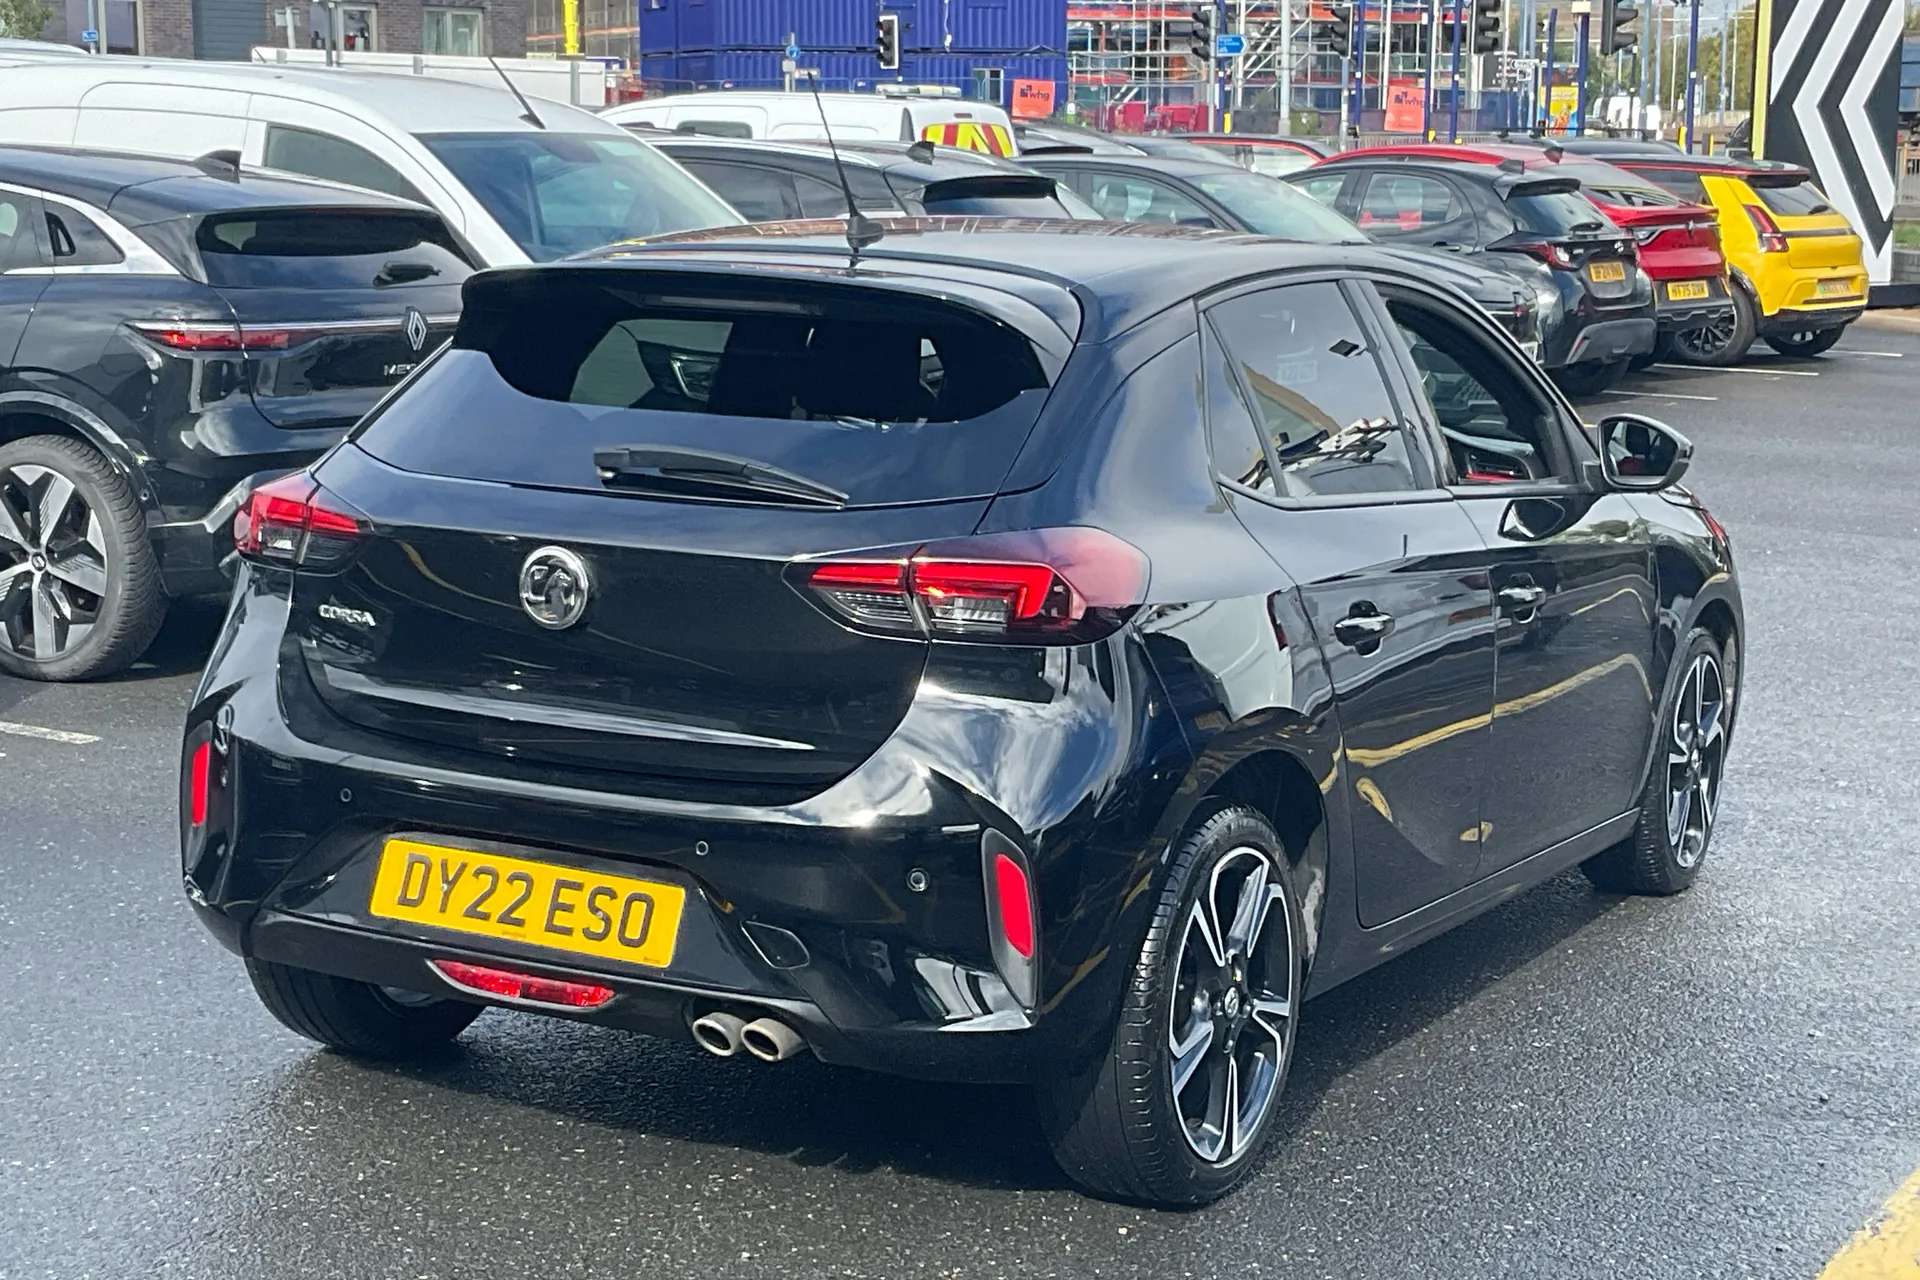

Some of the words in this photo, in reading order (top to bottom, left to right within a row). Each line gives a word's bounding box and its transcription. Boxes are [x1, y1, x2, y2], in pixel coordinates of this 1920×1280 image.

[319, 604, 376, 627] CORSA
[397, 852, 534, 927] DY22
[545, 878, 655, 948] ESO
